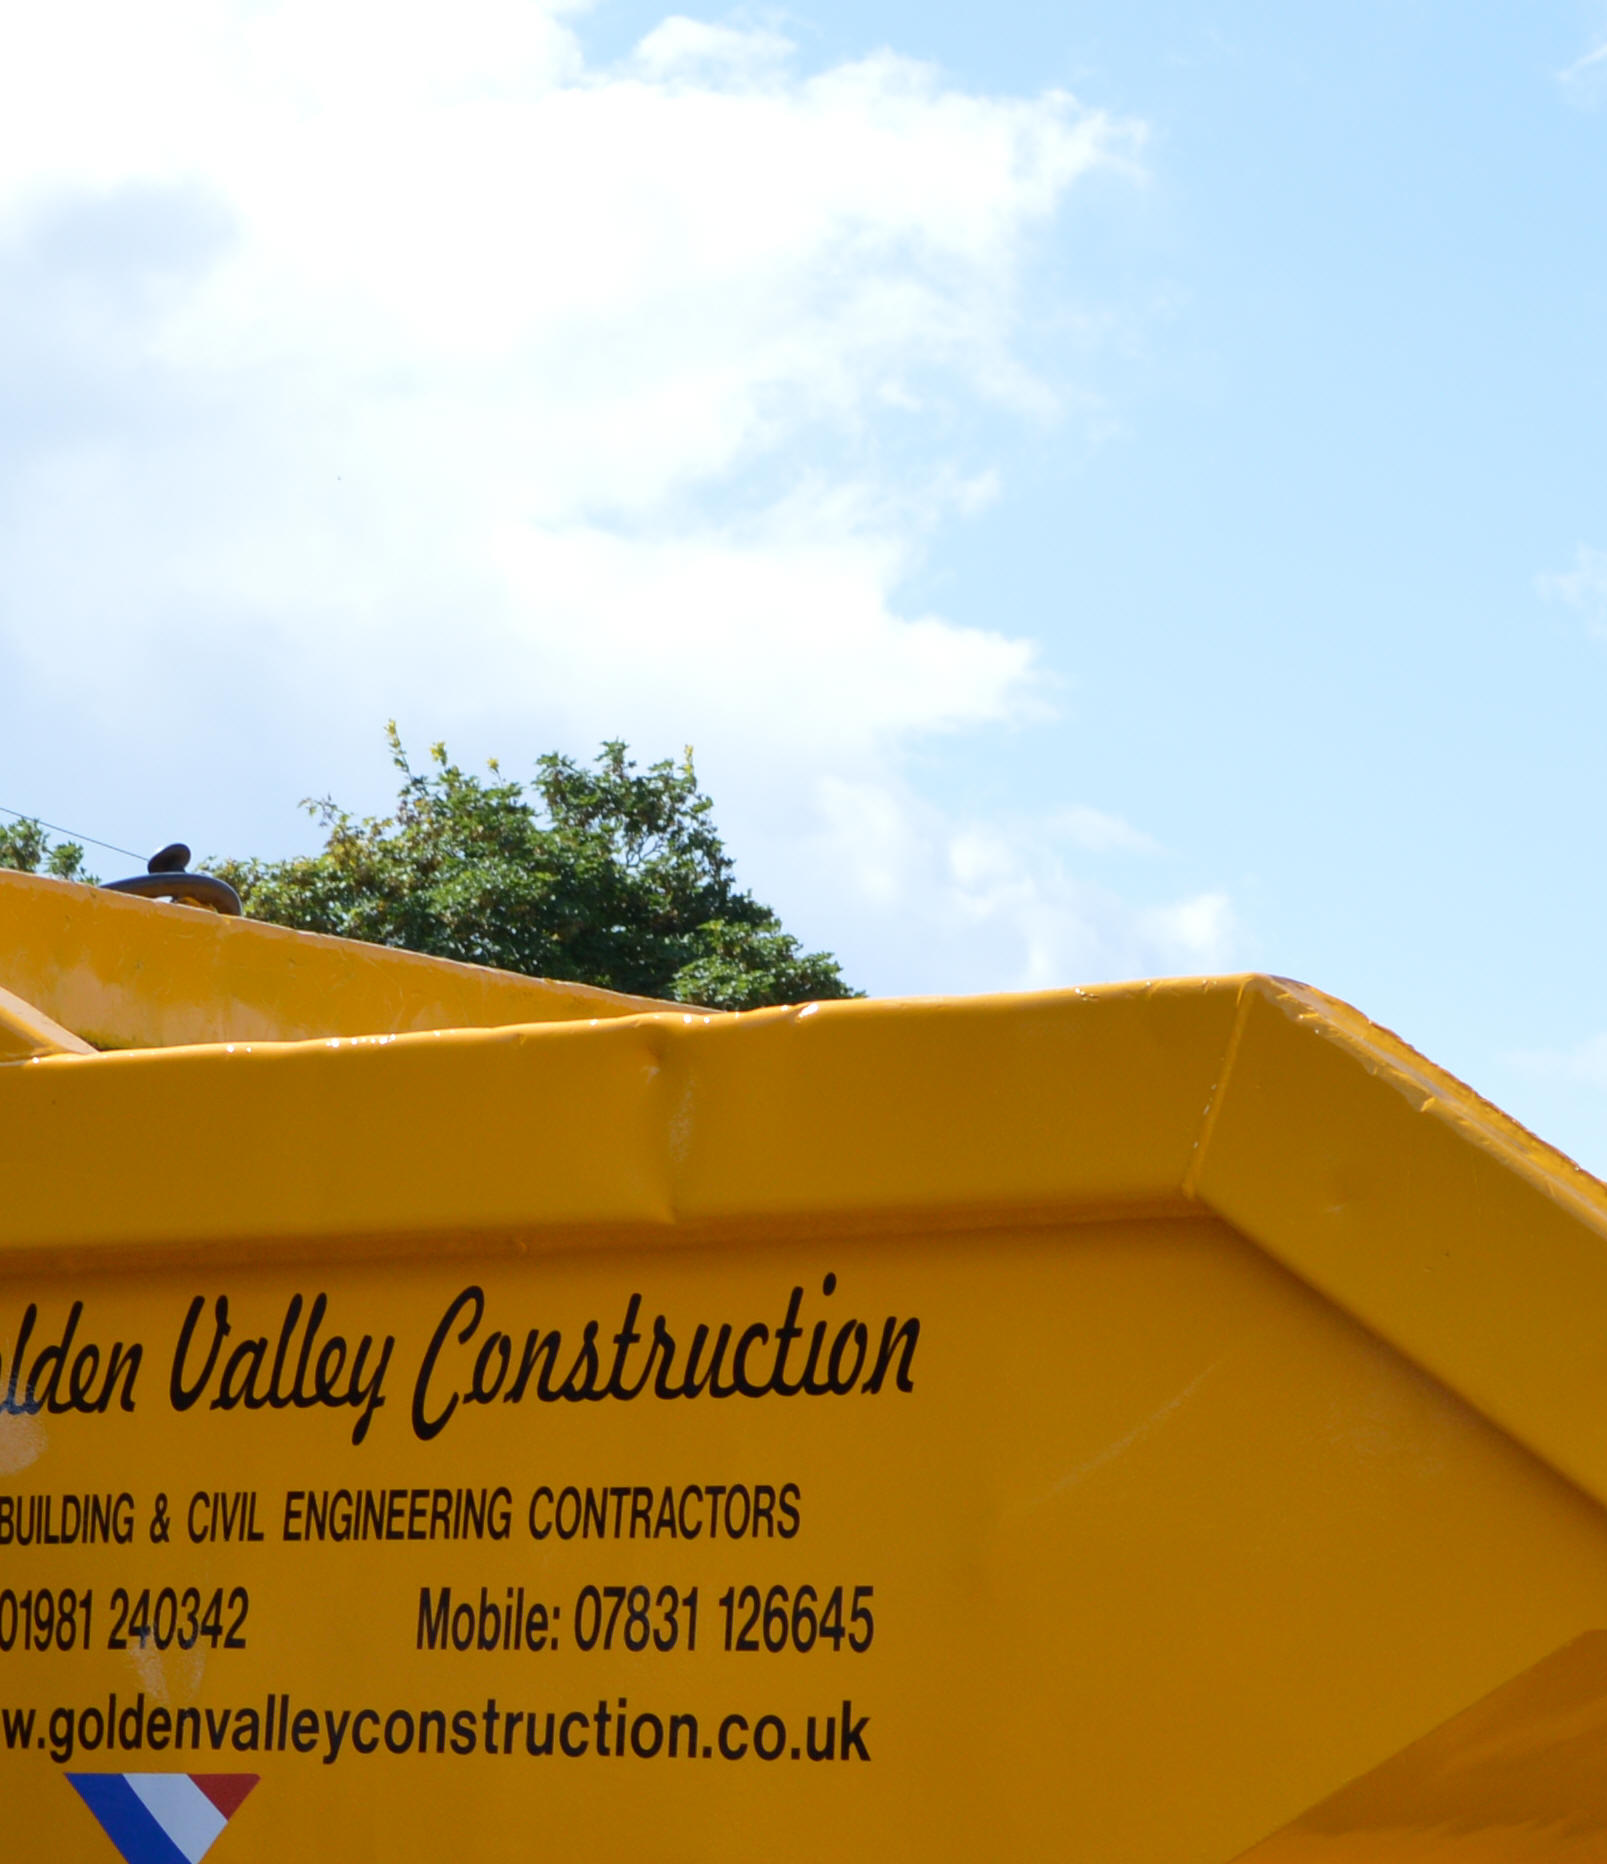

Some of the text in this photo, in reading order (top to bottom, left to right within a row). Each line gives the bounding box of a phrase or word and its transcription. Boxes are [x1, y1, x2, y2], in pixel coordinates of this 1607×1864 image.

[168, 1291, 396, 1447] Valley
[411, 1271, 922, 1443] Construction
[149, 1491, 172, 1545] &
[187, 1489, 266, 1545] CIVIL
[281, 1487, 513, 1543] ENGINEERING
[527, 1482, 802, 1542] CONTRACTORS
[107, 1586, 250, 1651] 240342
[416, 1584, 875, 1654] Mobile: 07831 126645
